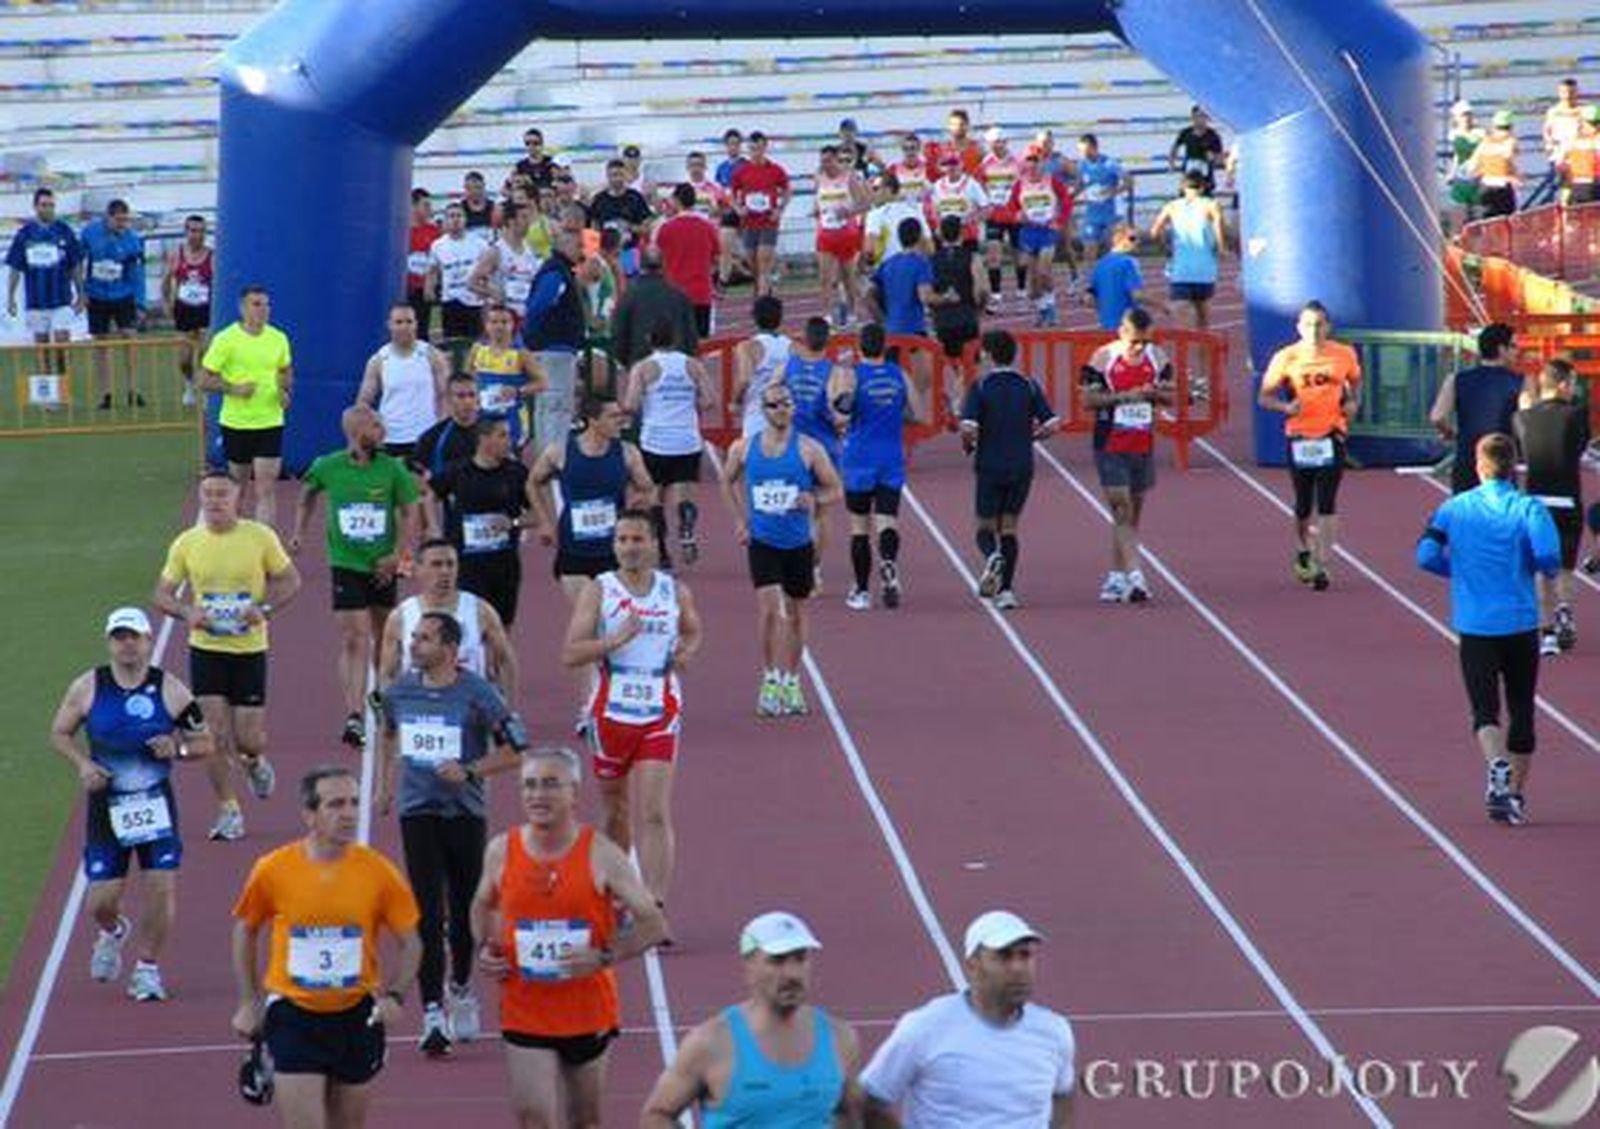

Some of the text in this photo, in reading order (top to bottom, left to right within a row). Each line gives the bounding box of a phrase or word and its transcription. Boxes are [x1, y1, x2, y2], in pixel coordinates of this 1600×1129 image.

[762, 492, 788, 505] 217
[349, 516, 375, 530] 274
[412, 733, 444, 751] 981
[122, 808, 156, 830] 552
[319, 950, 332, 970] 3
